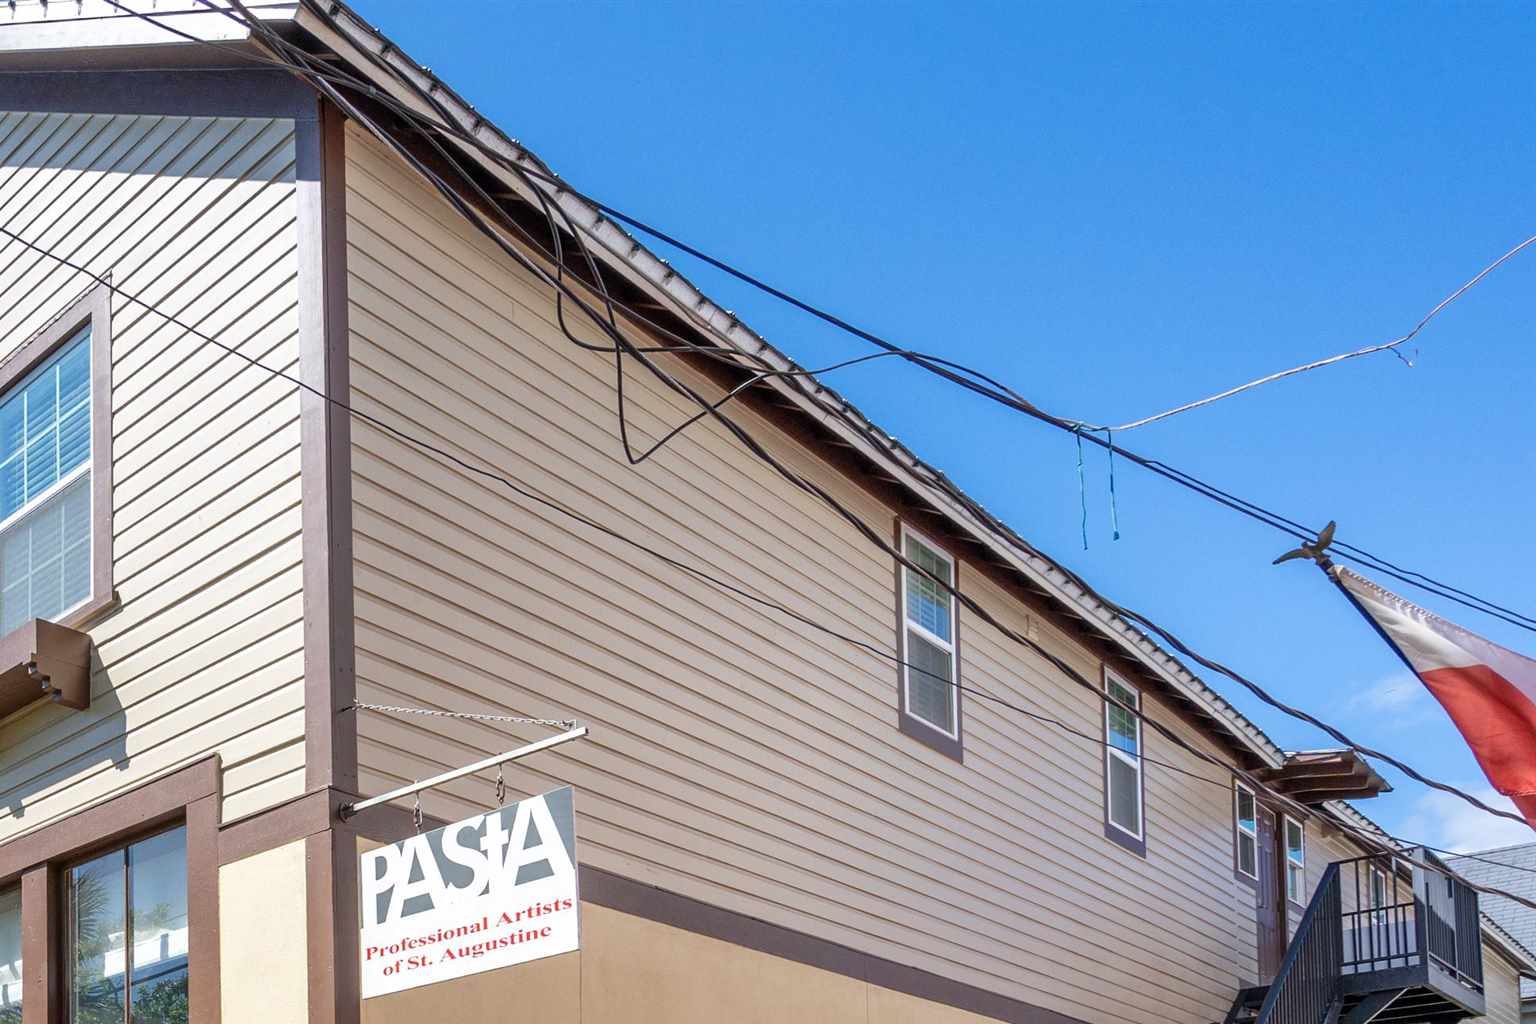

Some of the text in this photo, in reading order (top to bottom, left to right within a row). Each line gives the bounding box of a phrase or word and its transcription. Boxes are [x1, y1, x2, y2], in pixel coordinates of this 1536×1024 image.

[366, 897, 573, 961] Professional Artists
[382, 925, 552, 977] of St. Augustine
